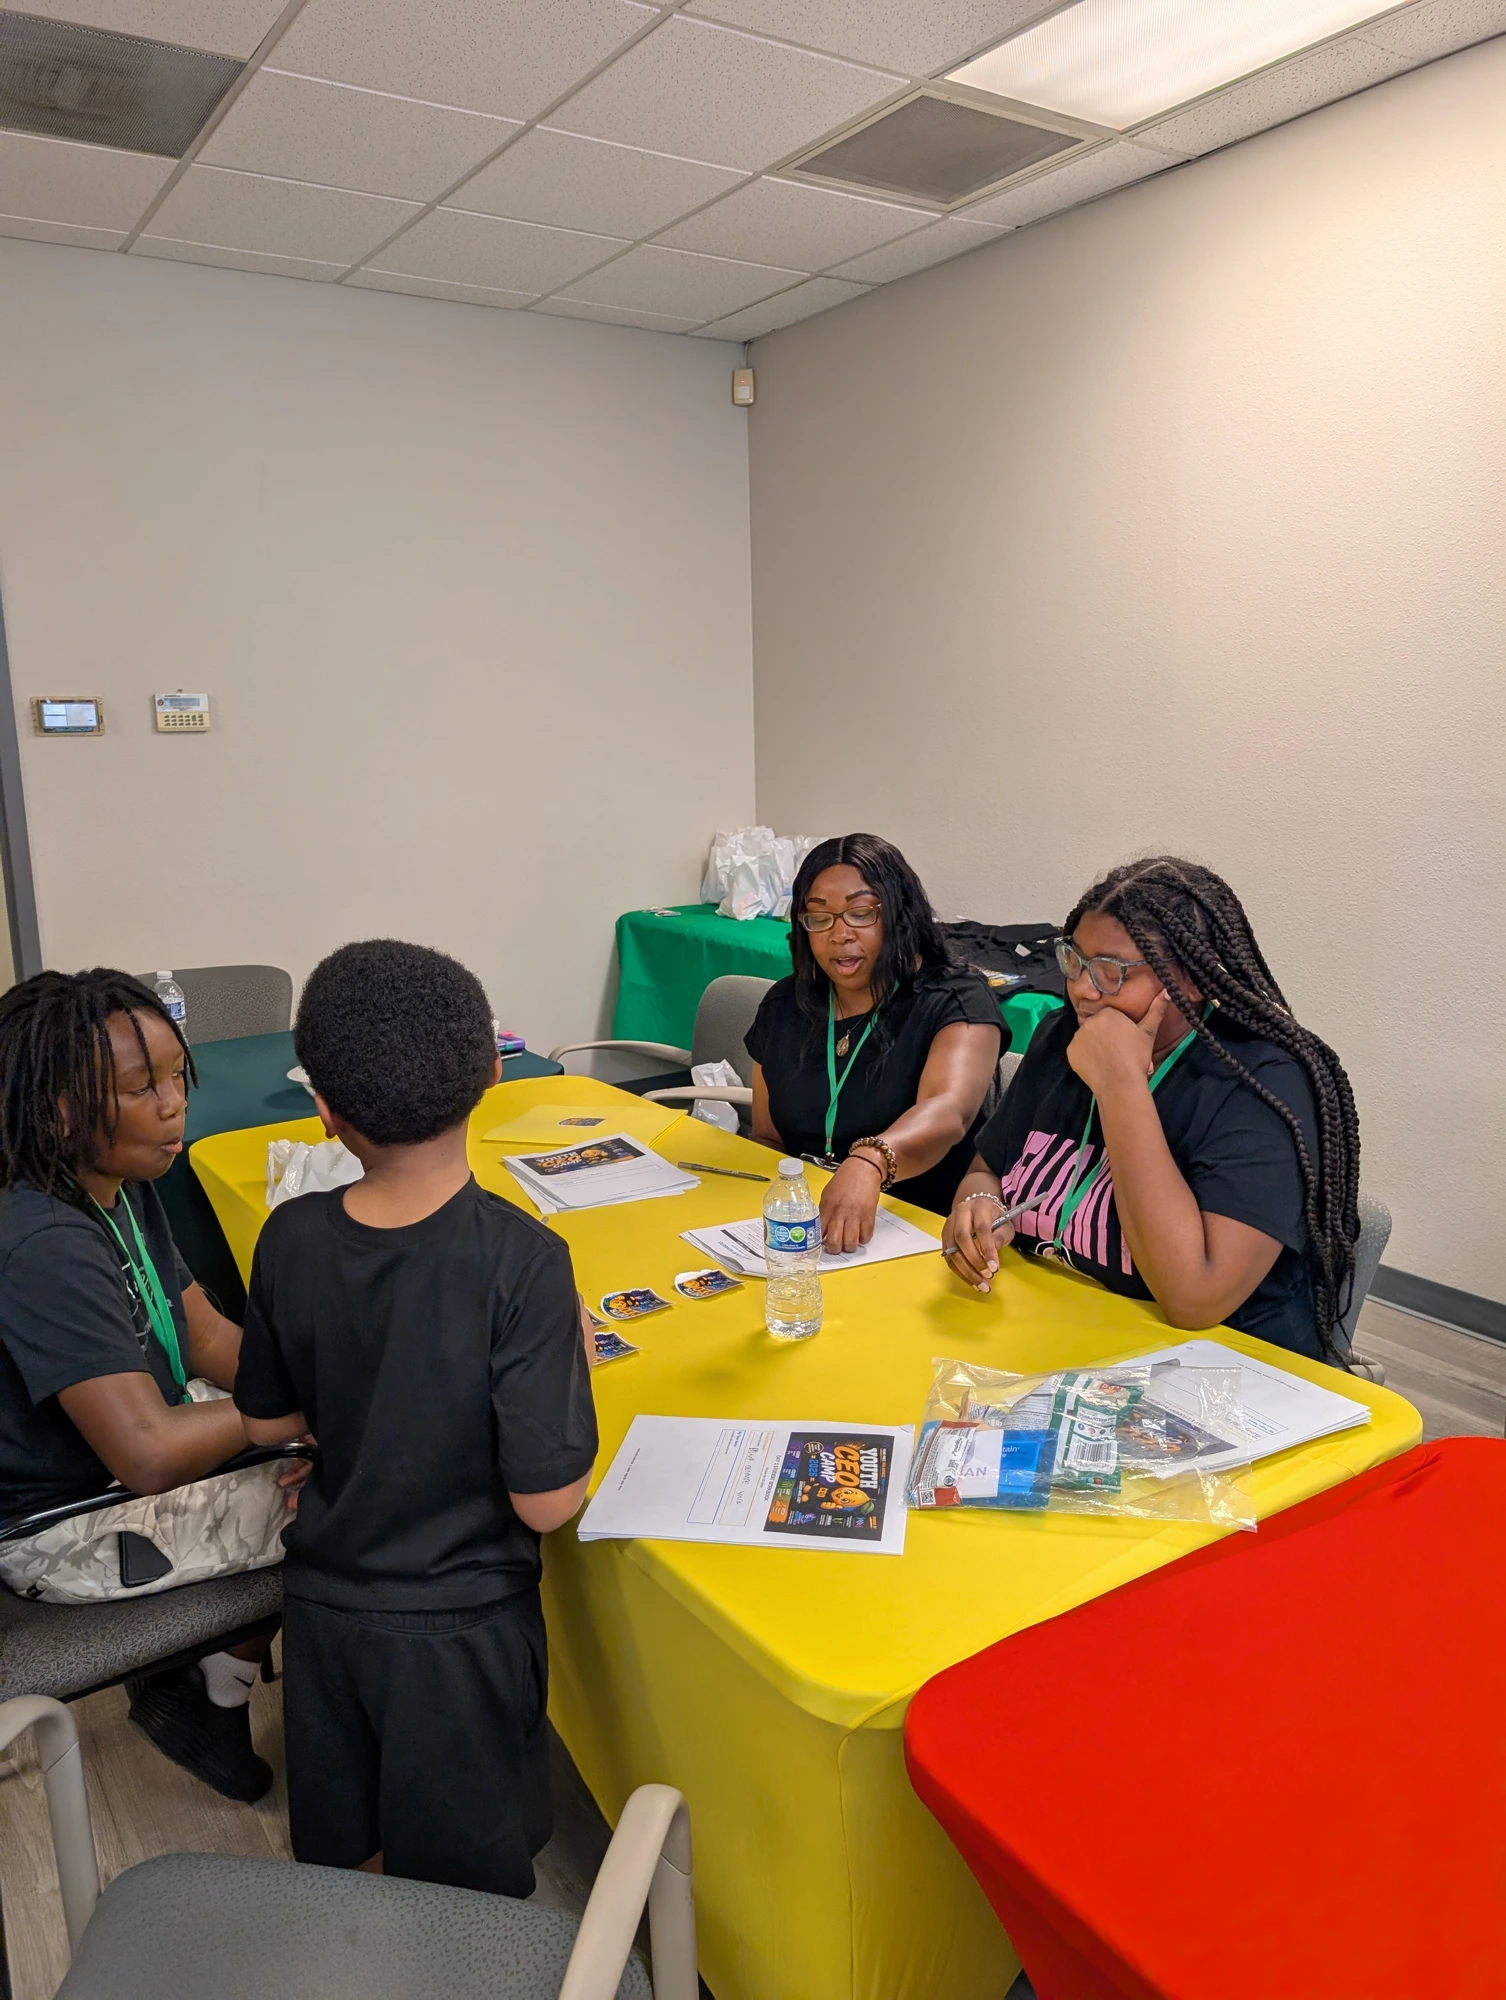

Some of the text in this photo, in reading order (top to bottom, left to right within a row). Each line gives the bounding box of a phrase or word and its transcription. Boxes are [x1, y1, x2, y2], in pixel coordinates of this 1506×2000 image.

[536, 1151, 579, 1163] YOUTH
[541, 1154, 581, 1168] CEO
[553, 1159, 582, 1169] CAMP
[769, 1465, 779, 1481] STUDENT
[808, 1459, 819, 1477] 2026
[820, 1451, 837, 1483] CAMP
[834, 1446, 860, 1487] CEO
[859, 1447, 879, 1489] YOUTH
[964, 1466, 988, 1477] AN
[763, 1480, 774, 1502] WORKBOOK
[817, 1487, 828, 1498] CEO
